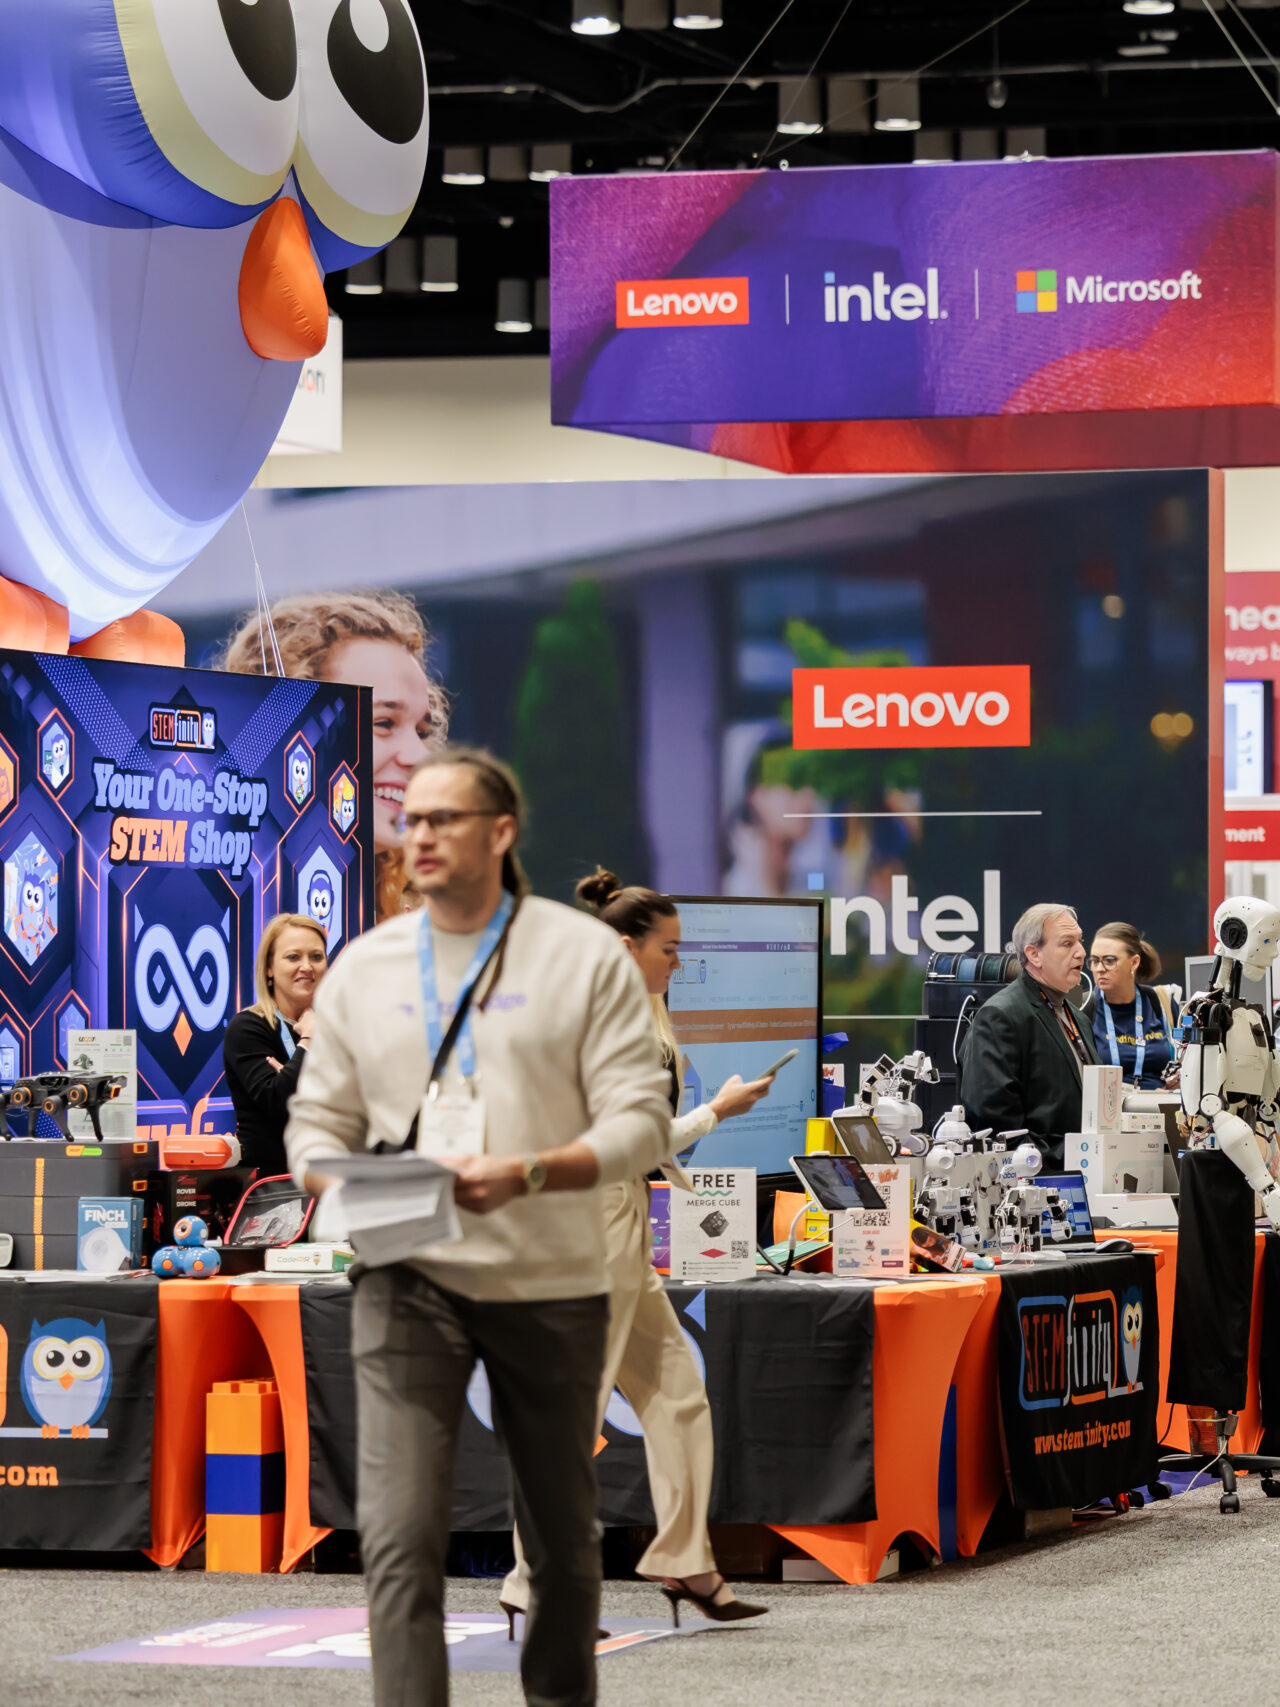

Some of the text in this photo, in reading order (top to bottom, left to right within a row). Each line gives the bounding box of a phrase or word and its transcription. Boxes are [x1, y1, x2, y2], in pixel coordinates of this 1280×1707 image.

[1066, 269, 1203, 306] Microsoft
[626, 291, 738, 317] Lenovo
[814, 685, 1010, 728] Lenovo
[95, 763, 268, 827] Your One-Stop
[110, 816, 250, 875] STEM Shop
[693, 1174, 736, 1188] FREE
[84, 1210, 125, 1222] FINCH
[687, 1199, 741, 1207] MERGE CUBE
